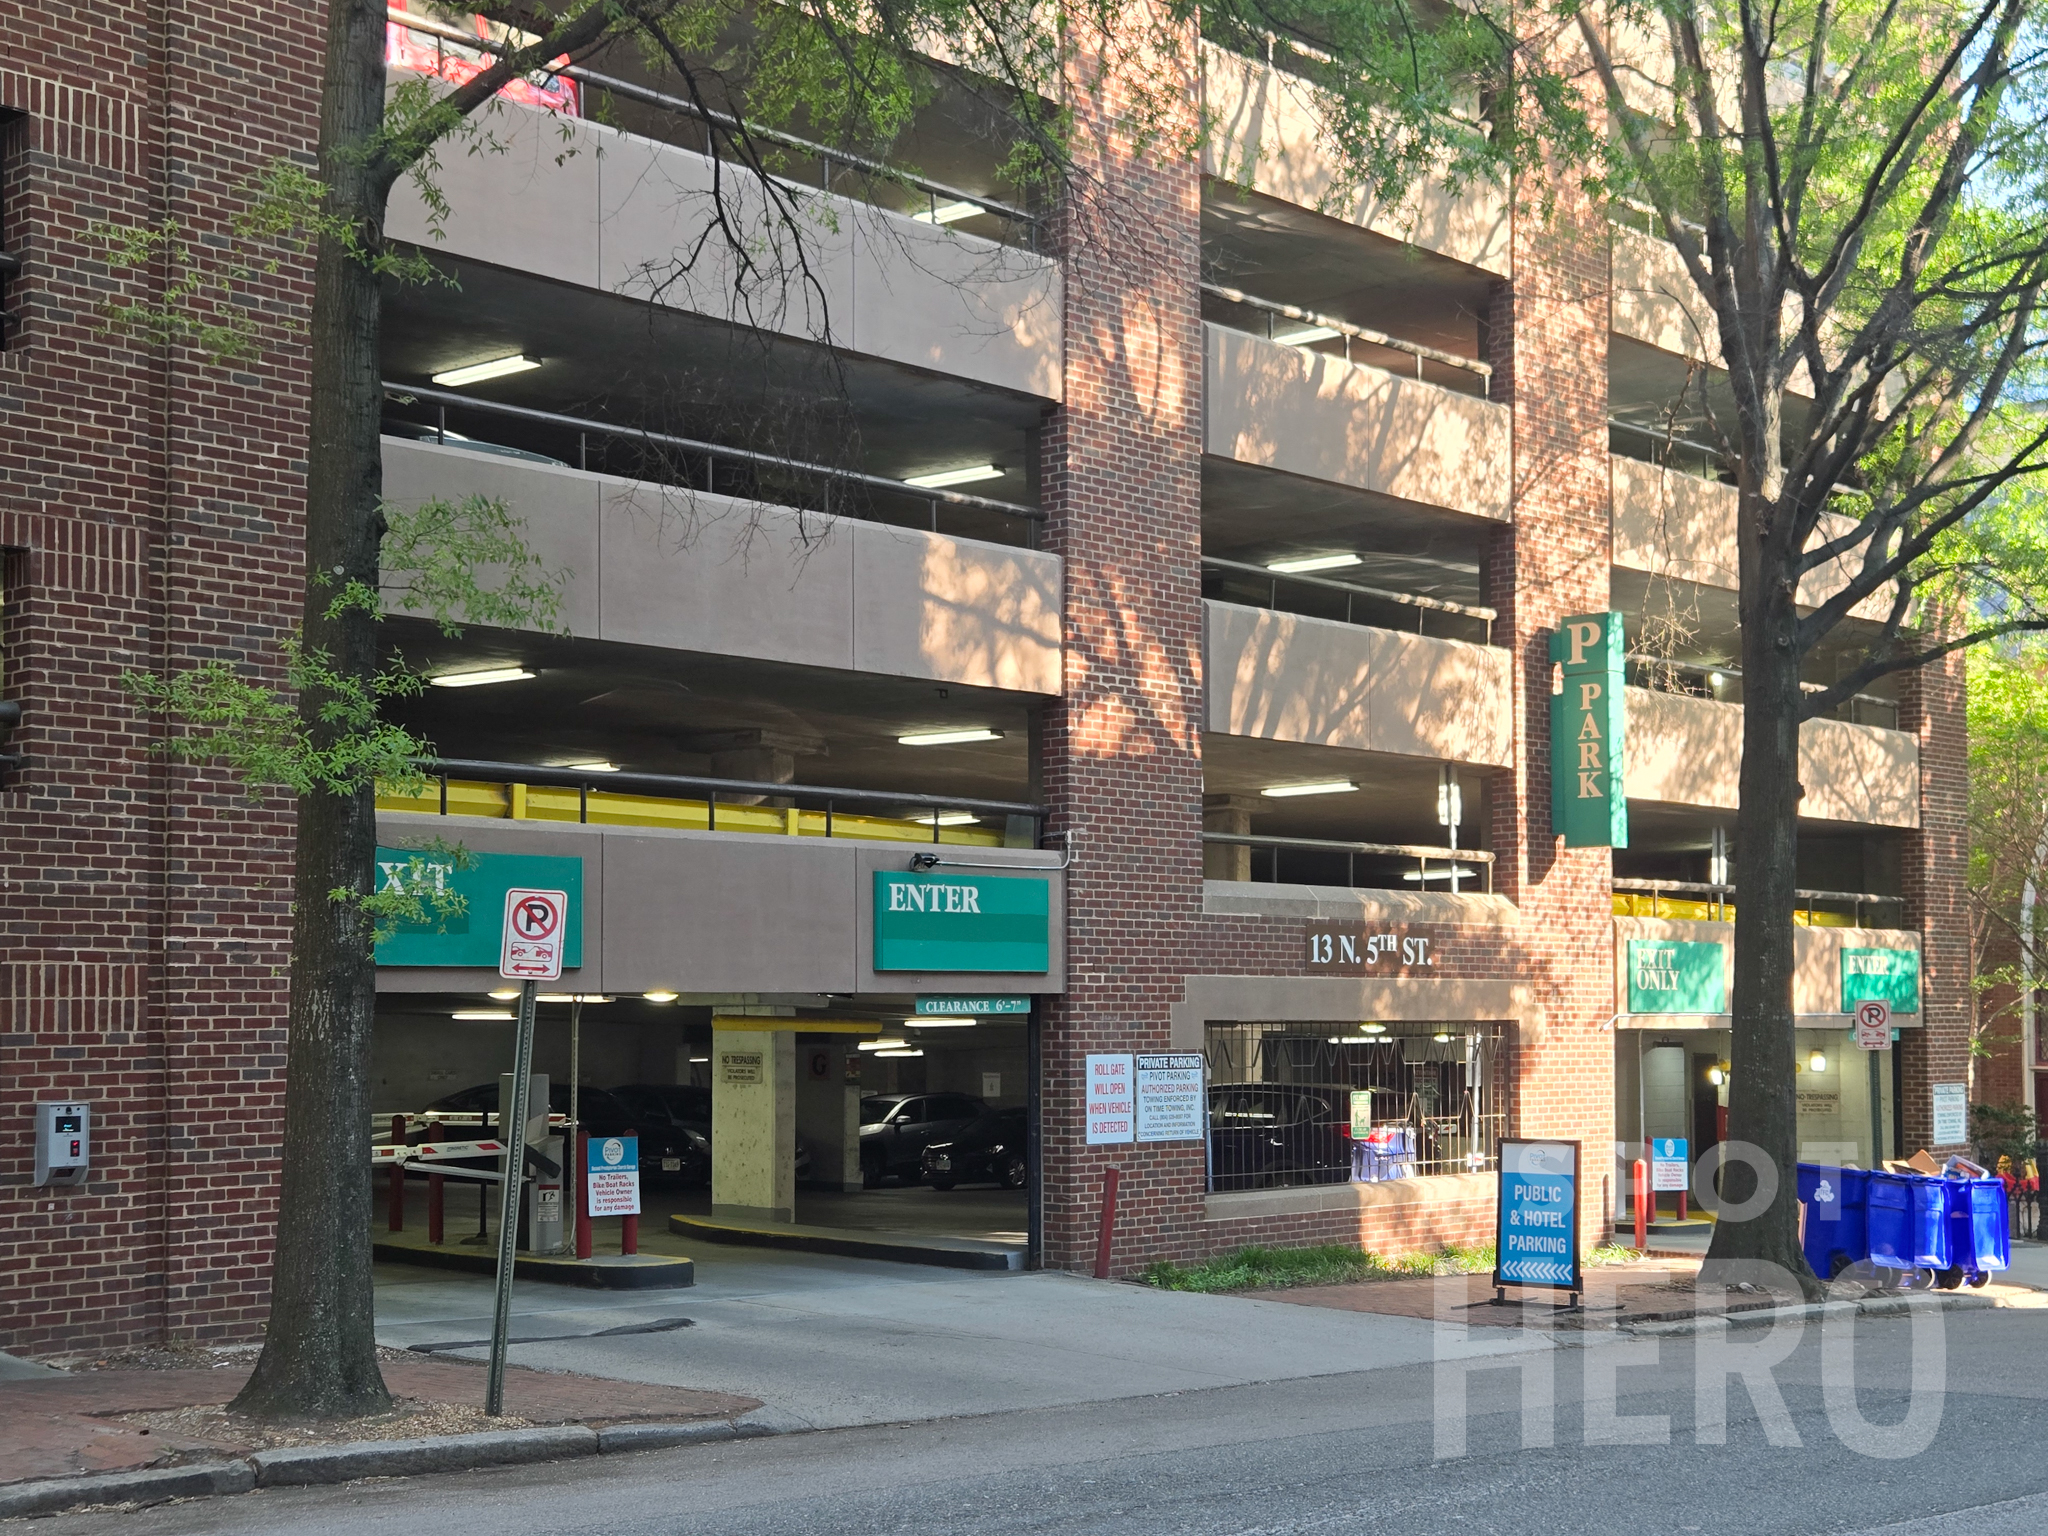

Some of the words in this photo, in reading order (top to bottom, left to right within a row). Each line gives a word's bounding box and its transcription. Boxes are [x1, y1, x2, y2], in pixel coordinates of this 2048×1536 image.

[1567, 622, 1601, 665] P
[1577, 683, 1604, 798] PARK
[374, 862, 453, 896] XIT
[888, 883, 981, 913] ENTER
[1310, 934, 1333, 964] 13
[1338, 935, 1361, 964] N.
[1366, 934, 1397, 965] 5TH
[1402, 937, 1433, 966] ST.
[1636, 948, 1675, 970] EXIT
[1848, 955, 1890, 975] ENTER
[1636, 969, 1680, 991] ONLY
[925, 1001, 990, 1013] CLEARANCE
[721, 1055, 730, 1064] NO
[731, 1055, 761, 1065] TRESPASSING
[1139, 1058, 1168, 1069] PRIVATE
[1169, 1057, 1200, 1069] PARKING
[1094, 1064, 1110, 1076] ROLL
[1110, 1063, 1125, 1075] GATE
[1149, 1072, 1166, 1080] PIVOT
[1166, 1071, 1191, 1080] PARKING
[1094, 1083, 1109, 1095] WILL
[1109, 1082, 1126, 1095] OPEN
[1141, 1084, 1175, 1094] AUTHORIZED
[1175, 1083, 1199, 1093] PARKING
[1143, 1095, 1163, 1103] TOWING
[1163, 1094, 1190, 1102] ENFORCED
[1189, 1094, 1197, 1102] BY
[1806, 1093, 1839, 1101] TRESPASSING
[1089, 1103, 1107, 1115] WHEN
[1108, 1102, 1131, 1113] VEHICLE
[1144, 1105, 1153, 1113] ON
[1092, 1122, 1099, 1134] IS
[1099, 1121, 1128, 1133] DETECTED
[602, 1196, 632, 1204] responsible
[1514, 1184, 1562, 1203] PUBLIC
[1509, 1209, 1521, 1226] &
[1523, 1210, 1566, 1228] HOTEL
[1508, 1235, 1567, 1254] PARKING
